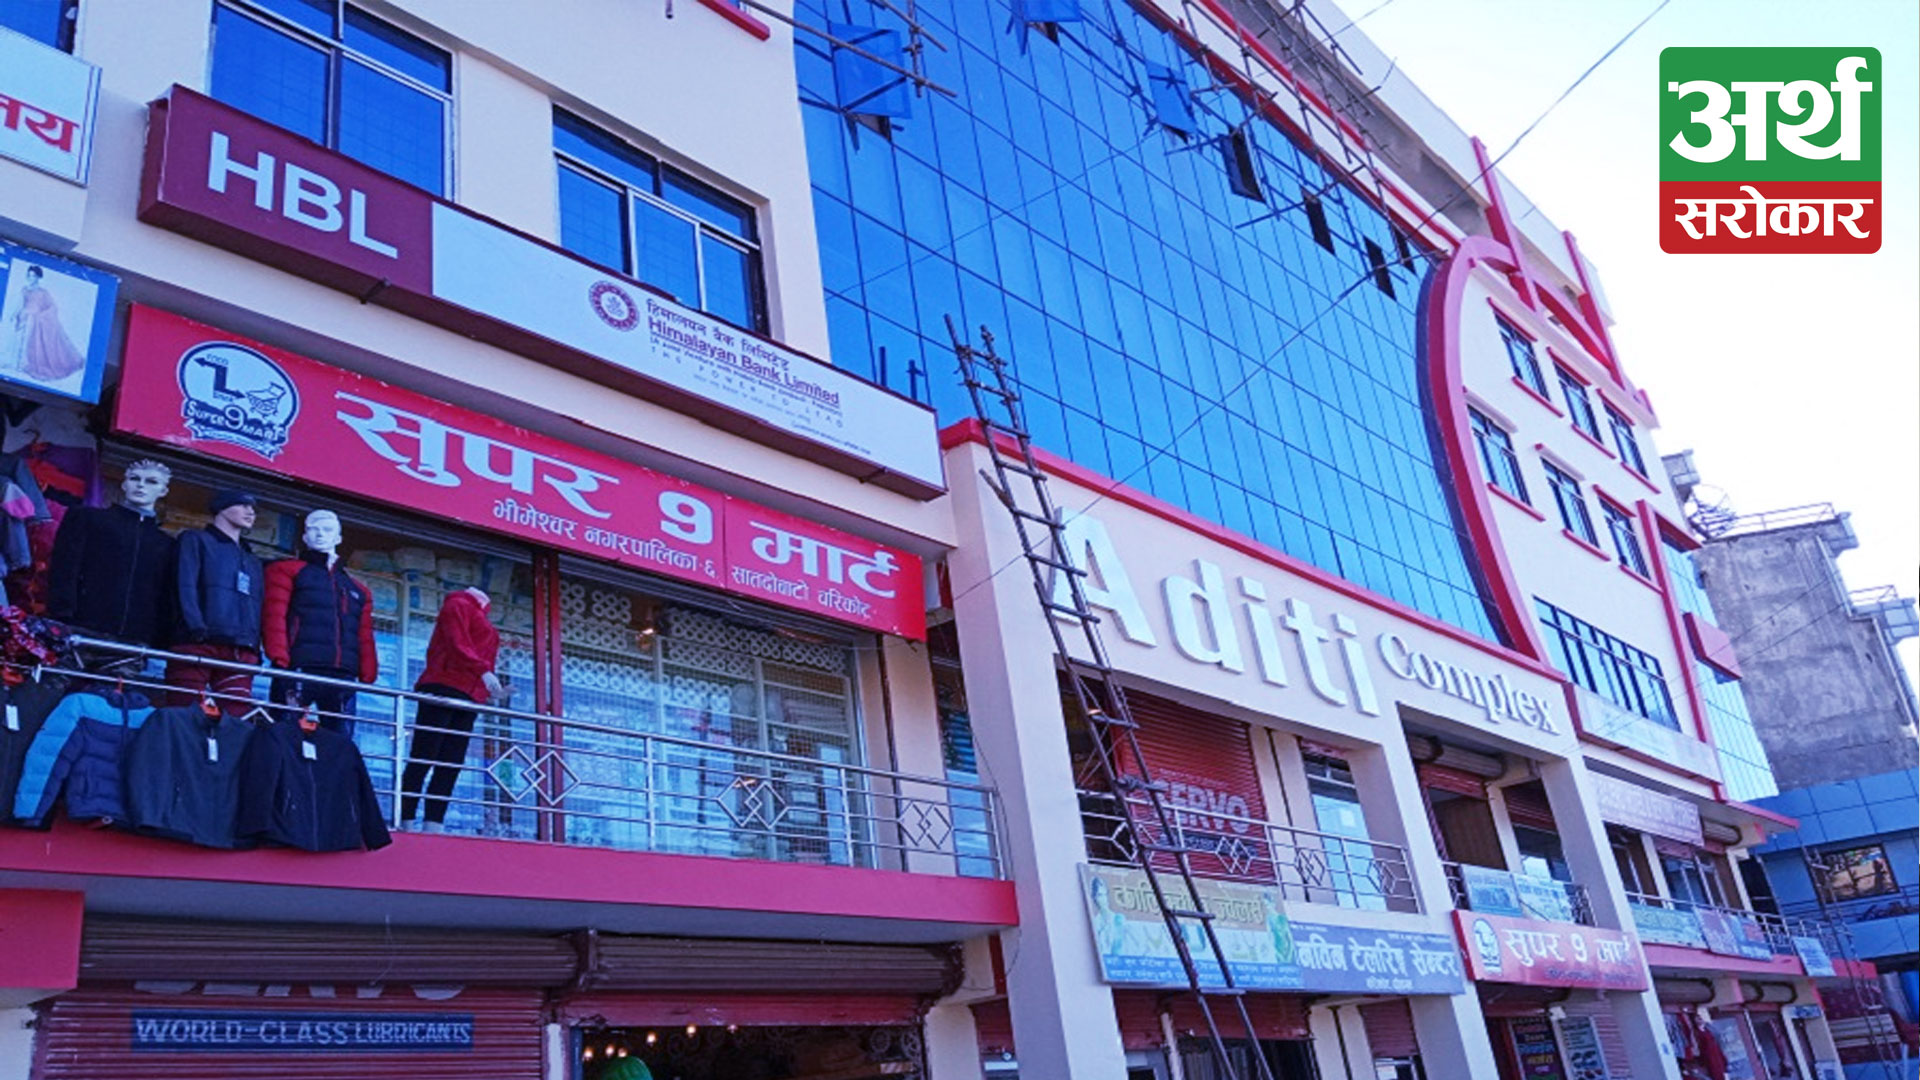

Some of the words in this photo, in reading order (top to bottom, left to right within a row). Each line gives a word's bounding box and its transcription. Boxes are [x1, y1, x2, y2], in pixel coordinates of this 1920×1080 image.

[208, 131, 398, 259] HBL
[647, 315, 738, 366] Himalayan
[741, 354, 781, 382] Bank
[784, 371, 840, 404] Limited
[335, 390, 620, 519] सुपर
[658, 490, 713, 545] 9
[750, 520, 900, 598] मार्ट
[493, 498, 577, 540] भीमेश्वर
[1050, 506, 1380, 717] Aditi
[1379, 632, 1562, 736] Complex
[1501, 928, 1565, 967] सुपर
[1570, 932, 1588, 963] 9
[134, 1017, 350, 1045] WORLD-CLASS
[353, 1021, 472, 1045] LUBRICANTS
